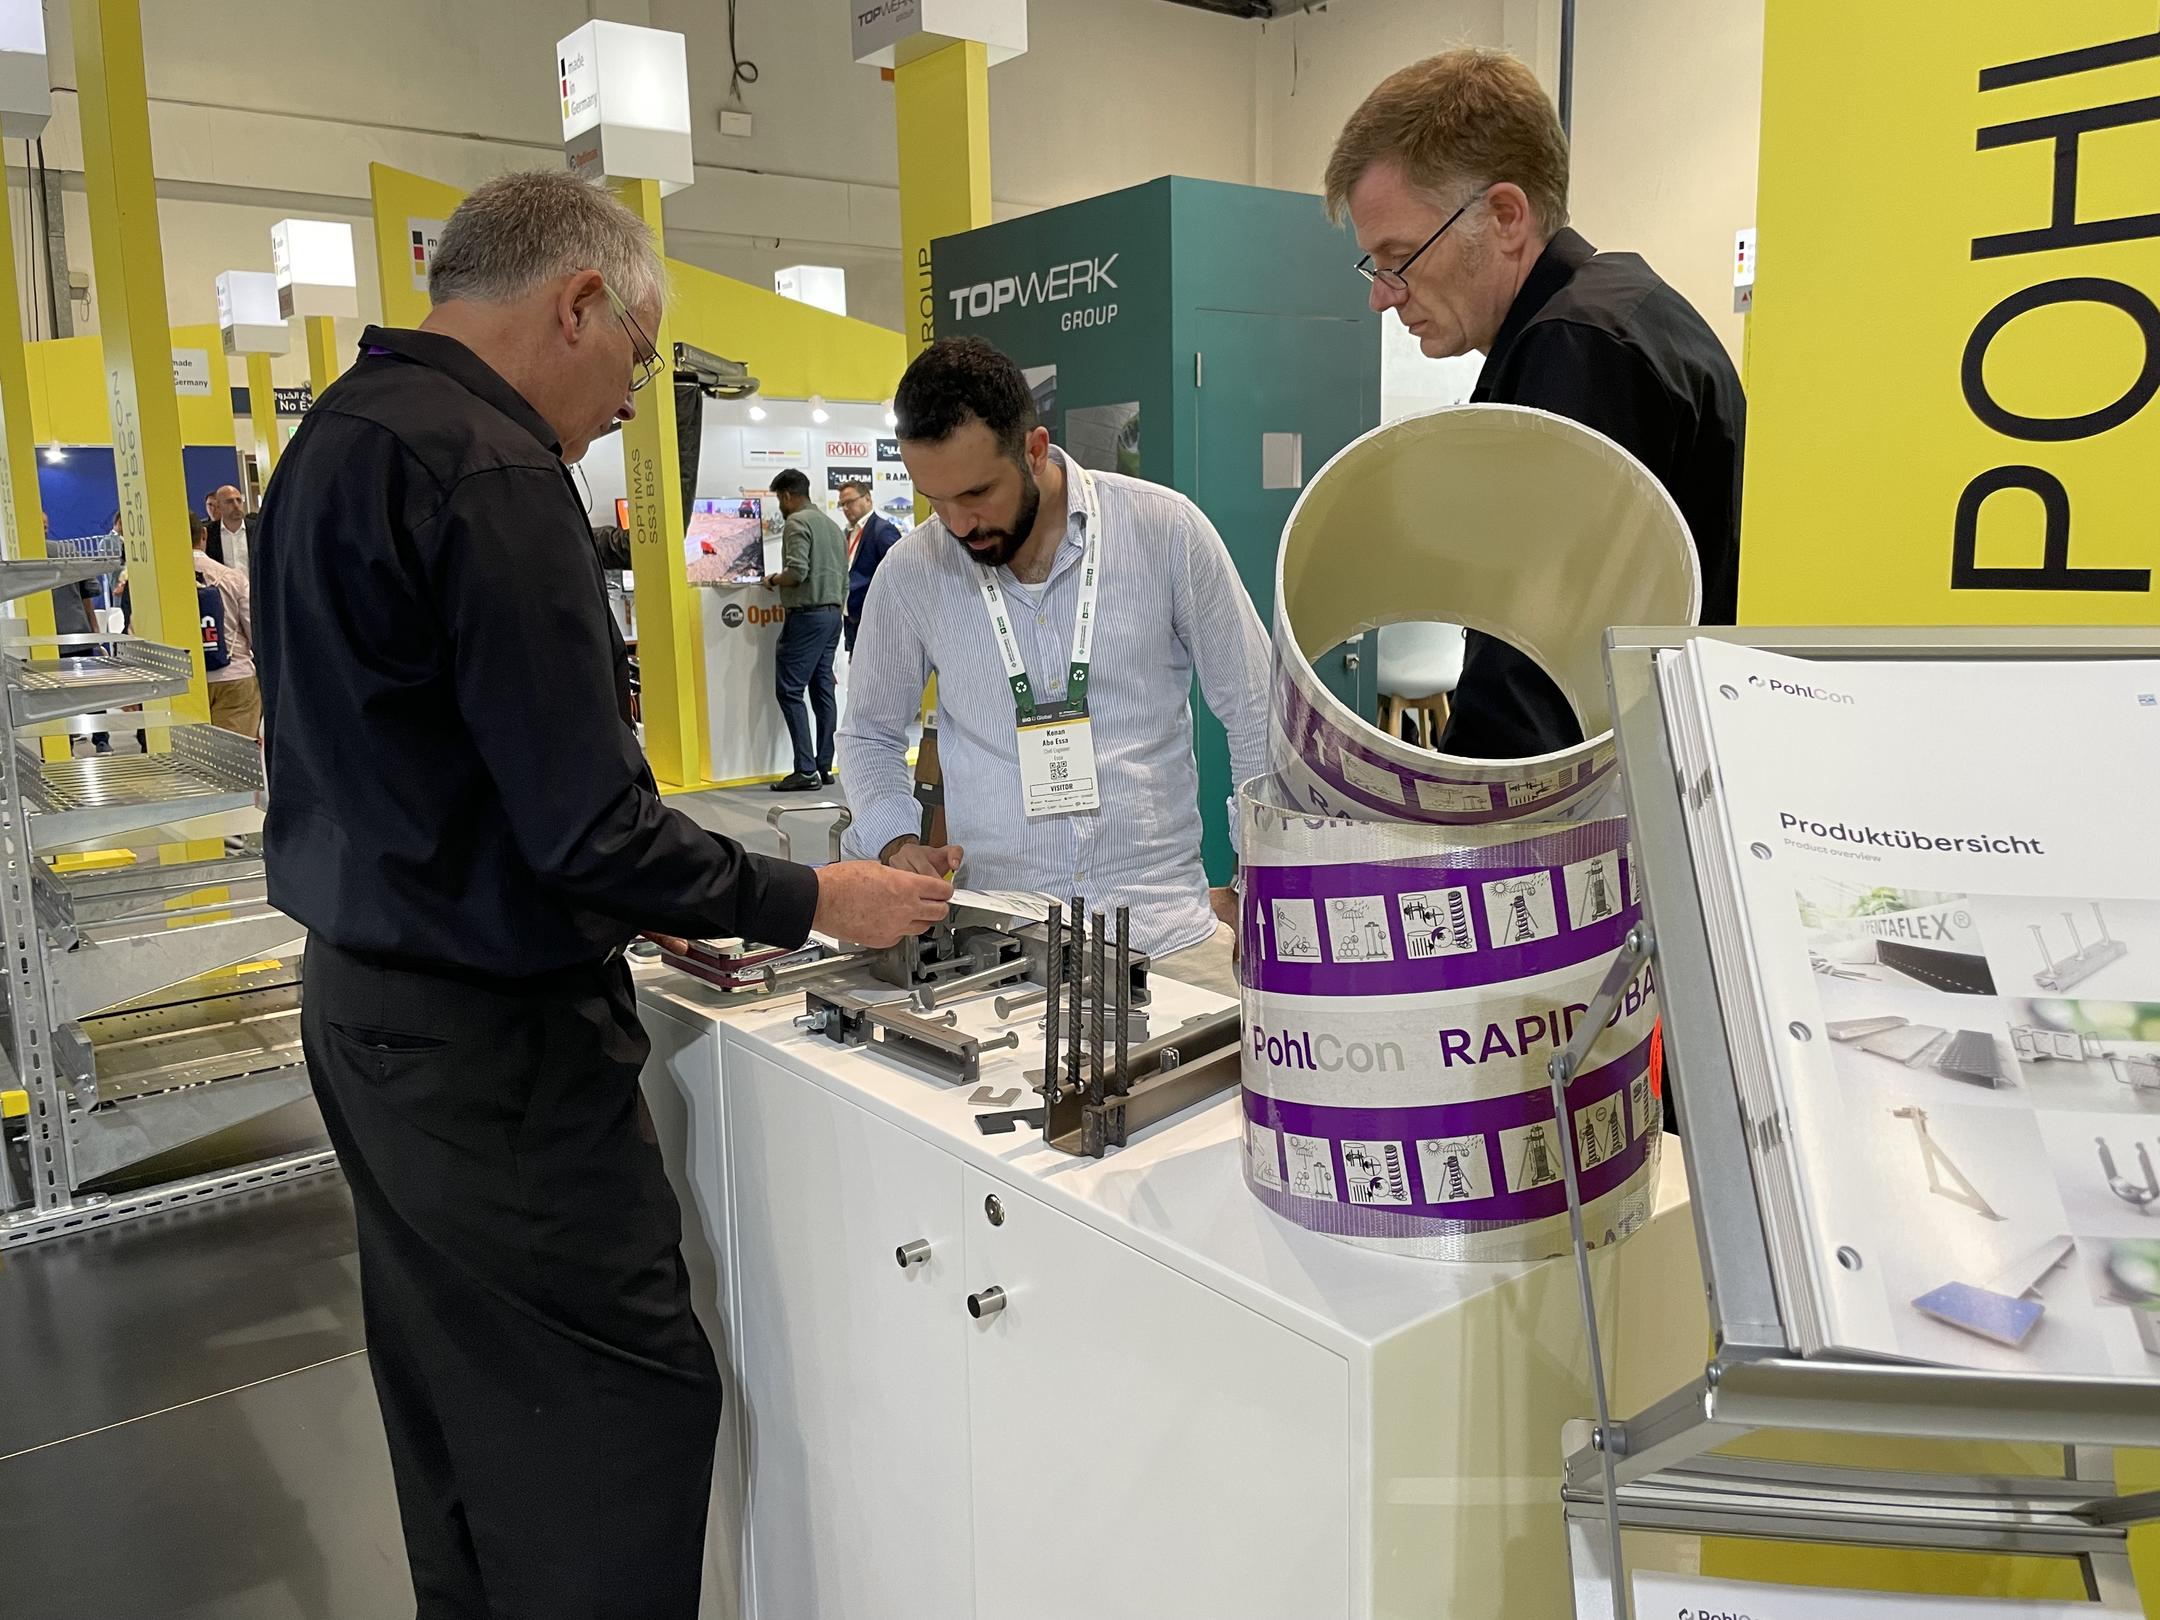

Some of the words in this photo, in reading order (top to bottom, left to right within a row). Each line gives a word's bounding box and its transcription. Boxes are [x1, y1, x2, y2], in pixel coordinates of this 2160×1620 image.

[858, 0, 914, 27] TOPWER
[567, 52, 584, 74] made
[571, 93, 598, 116] Germany
[919, 247, 935, 347] ROUP
[949, 253, 1120, 321] TOPWERK
[1061, 304, 1118, 332] GROUP
[279, 400, 297, 411] No
[125, 412, 139, 475] B61
[112, 371, 139, 561] POHLCON
[645, 459, 655, 497] B58
[885, 472, 911, 481] RAM
[632, 449, 646, 544] OPTIMAS
[134, 491, 148, 563] SS3
[647, 504, 658, 544] SS3
[1769, 679, 1855, 705] PohlCon
[1050, 783, 1074, 792] VISITOR
[1779, 812, 2046, 855] Produktübersicht
[1783, 837, 1829, 854] Product
[1830, 849, 1882, 863] overview
[1252, 1024, 1406, 1073] PohlCon
